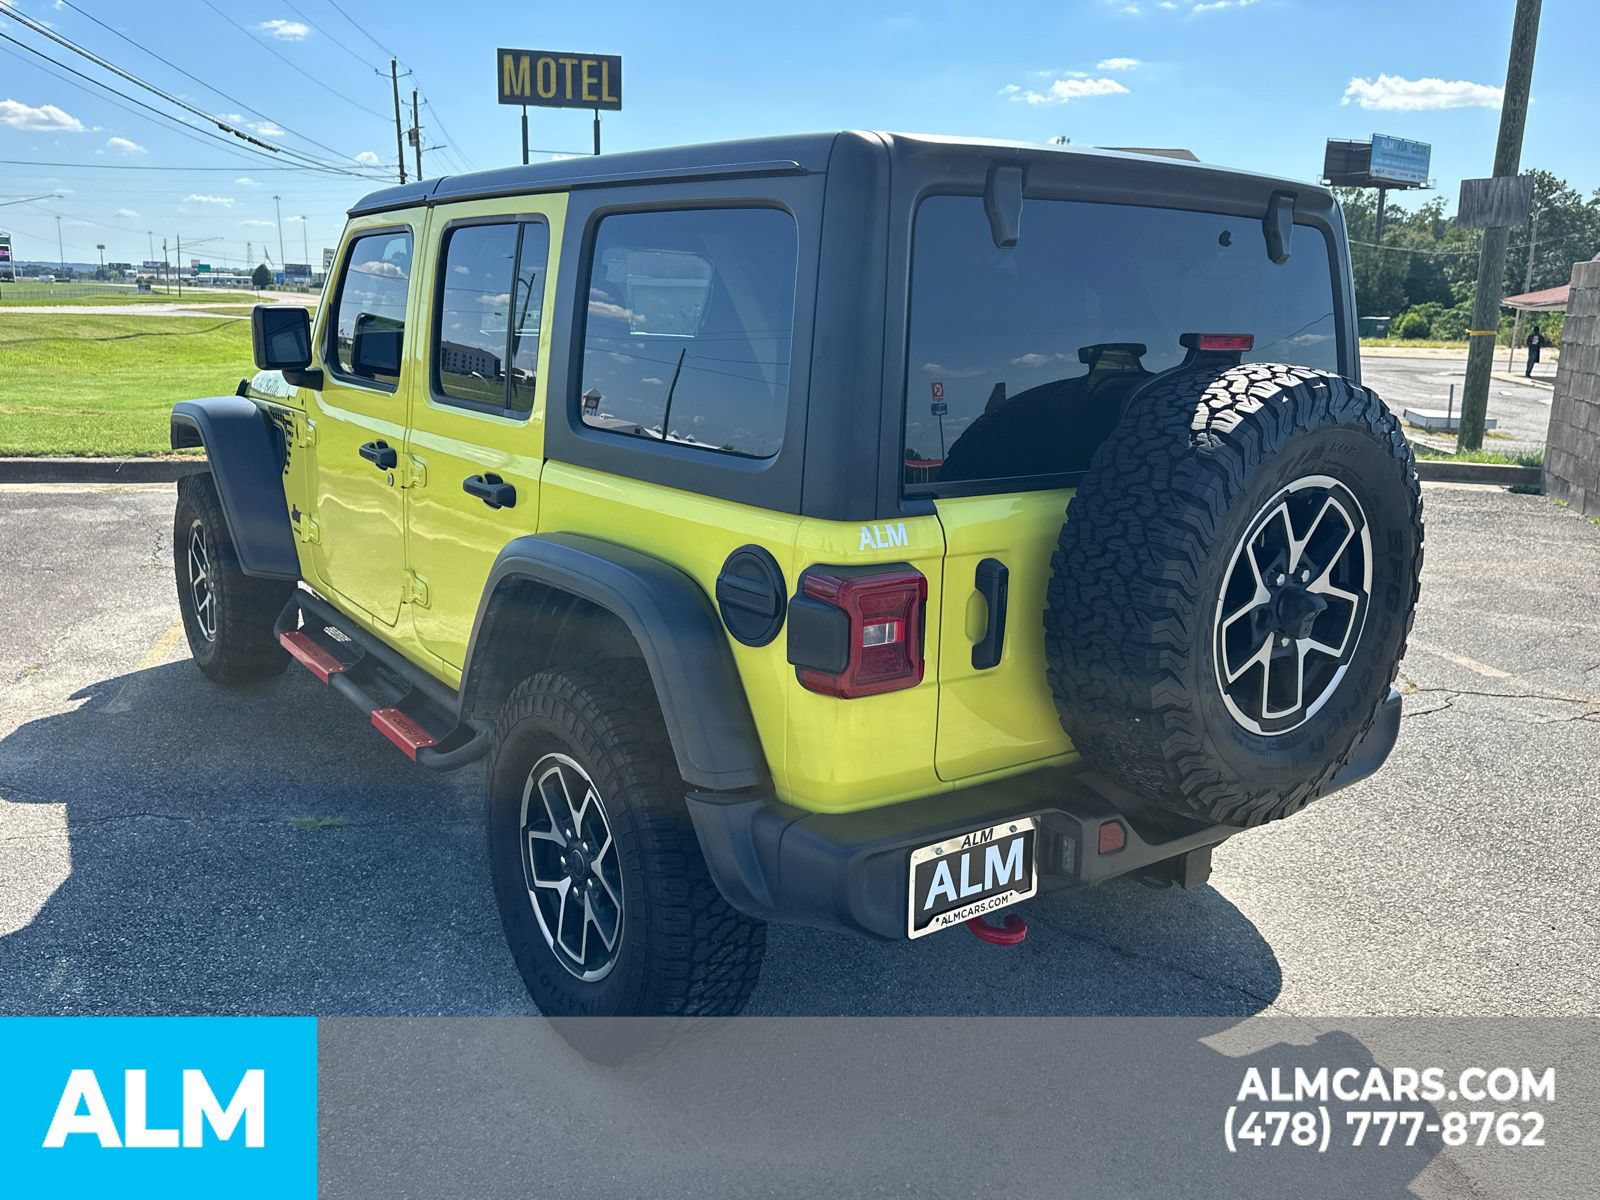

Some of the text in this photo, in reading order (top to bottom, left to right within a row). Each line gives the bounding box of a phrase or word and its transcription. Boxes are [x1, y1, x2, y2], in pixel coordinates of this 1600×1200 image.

[503, 54, 618, 103] MOTEL
[859, 522, 909, 551] ALM
[961, 827, 994, 850] ALM
[923, 836, 1024, 911] ALM
[940, 894, 1009, 926] ALMCARS.COM
